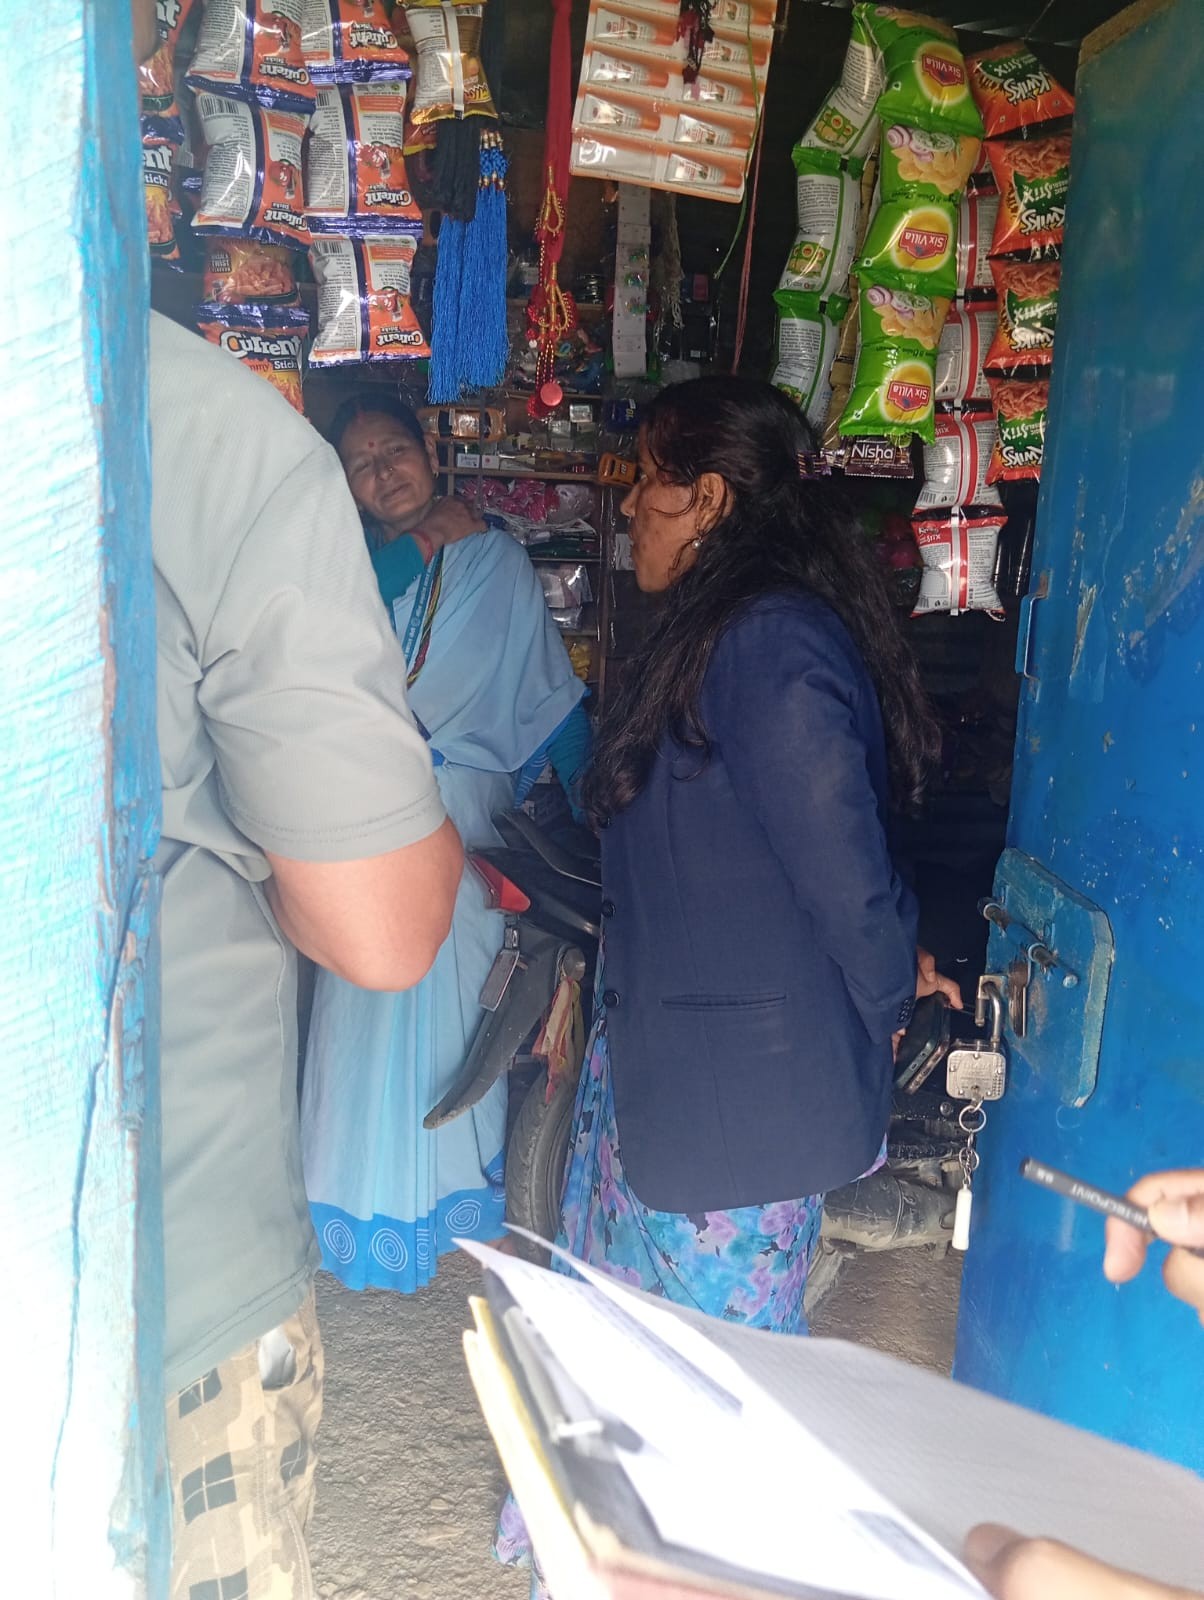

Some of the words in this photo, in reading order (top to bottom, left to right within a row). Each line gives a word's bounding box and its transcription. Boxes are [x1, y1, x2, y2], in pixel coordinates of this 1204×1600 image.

[350, 28, 399, 49] Current
[925, 57, 949, 74] Villa
[949, 65, 962, 78] Six
[260, 63, 310, 85] Current
[145, 175, 168, 187] ticks
[365, 190, 412, 206] Current
[264, 210, 308, 231] Current
[905, 232, 929, 246] Villa
[929, 236, 944, 248] Six
[220, 330, 301, 360] Current
[377, 331, 424, 347] Current
[893, 385, 915, 398] Villa
[915, 388, 928, 400] Six
